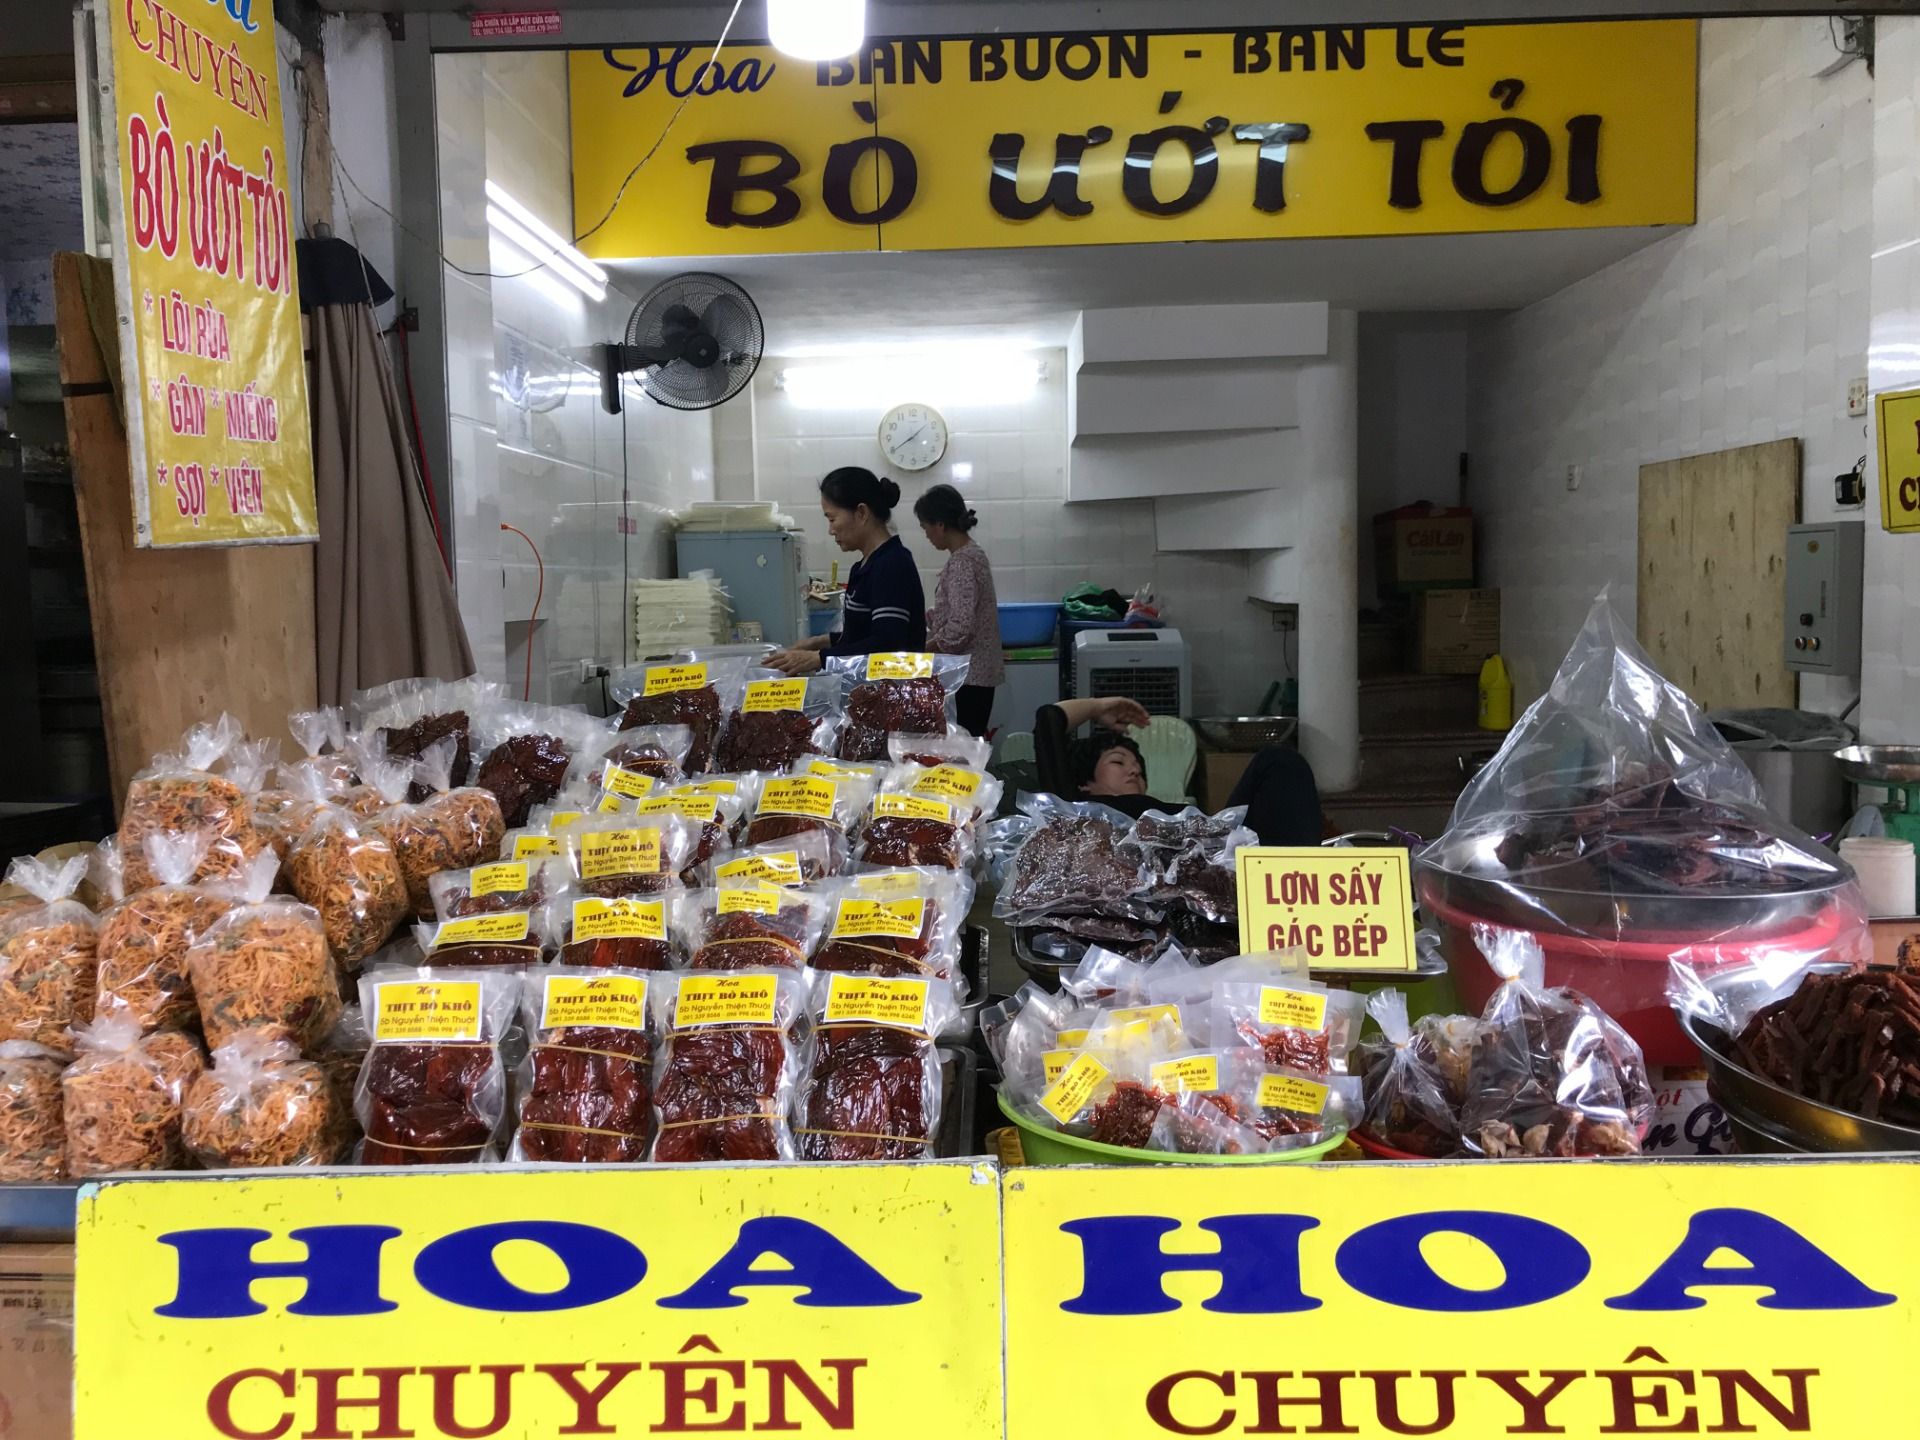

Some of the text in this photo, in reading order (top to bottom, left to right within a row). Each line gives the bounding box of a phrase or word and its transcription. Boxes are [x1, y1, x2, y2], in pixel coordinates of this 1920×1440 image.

[126, 0, 270, 127] CHUYÊN
[685, 78, 1602, 229] BÒ ƯỚT TỎI
[129, 93, 292, 298] BÒ ƯỚT TỎI
[194, 299, 232, 363] RÙA
[167, 374, 207, 437] GÂN
[224, 381, 278, 443] MIẾNG
[174, 463, 207, 527] SỢI
[224, 458, 264, 515] VIÊN
[768, 788, 829, 799] THỊT BÒ KHÔ
[587, 841, 654, 858] THỊT BÒ KHÔ
[1265, 862, 1382, 912] LỢN SẤY
[580, 912, 609, 922] THỊT
[1267, 913, 1388, 957] GÁC BẾP
[554, 992, 638, 1005] THỊT BÒ KHÔ
[586, 980, 610, 989] Hoa
[685, 989, 768, 1002] THỊT BÒ KHÔ
[716, 979, 739, 987] Hoa
[838, 992, 918, 1001] THỊT BÒ KHÔ
[868, 980, 891, 990] Hoa
[386, 1000, 472, 1013] THỊT BÒ KHÔ
[392, 1014, 424, 1026] Nguyễn
[691, 1002, 724, 1012] Nguyễn
[749, 1002, 770, 1010] Thuật
[843, 1000, 874, 1010] Nguyễn
[900, 1004, 921, 1012] Thuật
[153, 1215, 923, 1320] HOA
[1058, 1207, 1898, 1315] HOA
[206, 1334, 868, 1440] CHUYÊN
[1145, 1345, 1821, 1436] CHUYÊN
